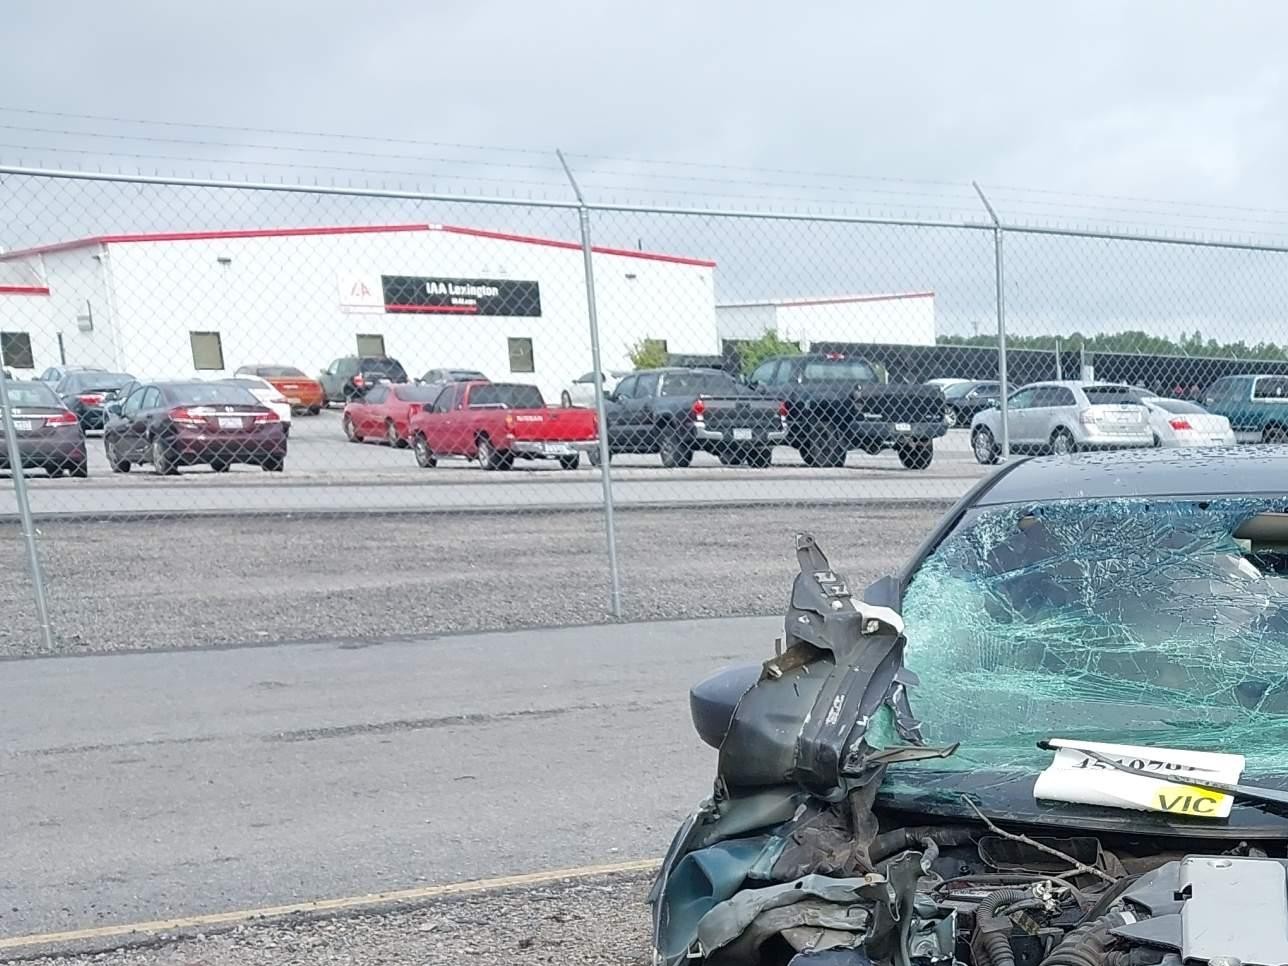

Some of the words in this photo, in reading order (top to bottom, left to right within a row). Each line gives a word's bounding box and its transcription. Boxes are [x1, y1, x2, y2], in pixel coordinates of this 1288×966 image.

[426, 282, 447, 294] IAA
[448, 283, 499, 298] Lexington
[1158, 794, 1217, 813] VIC
